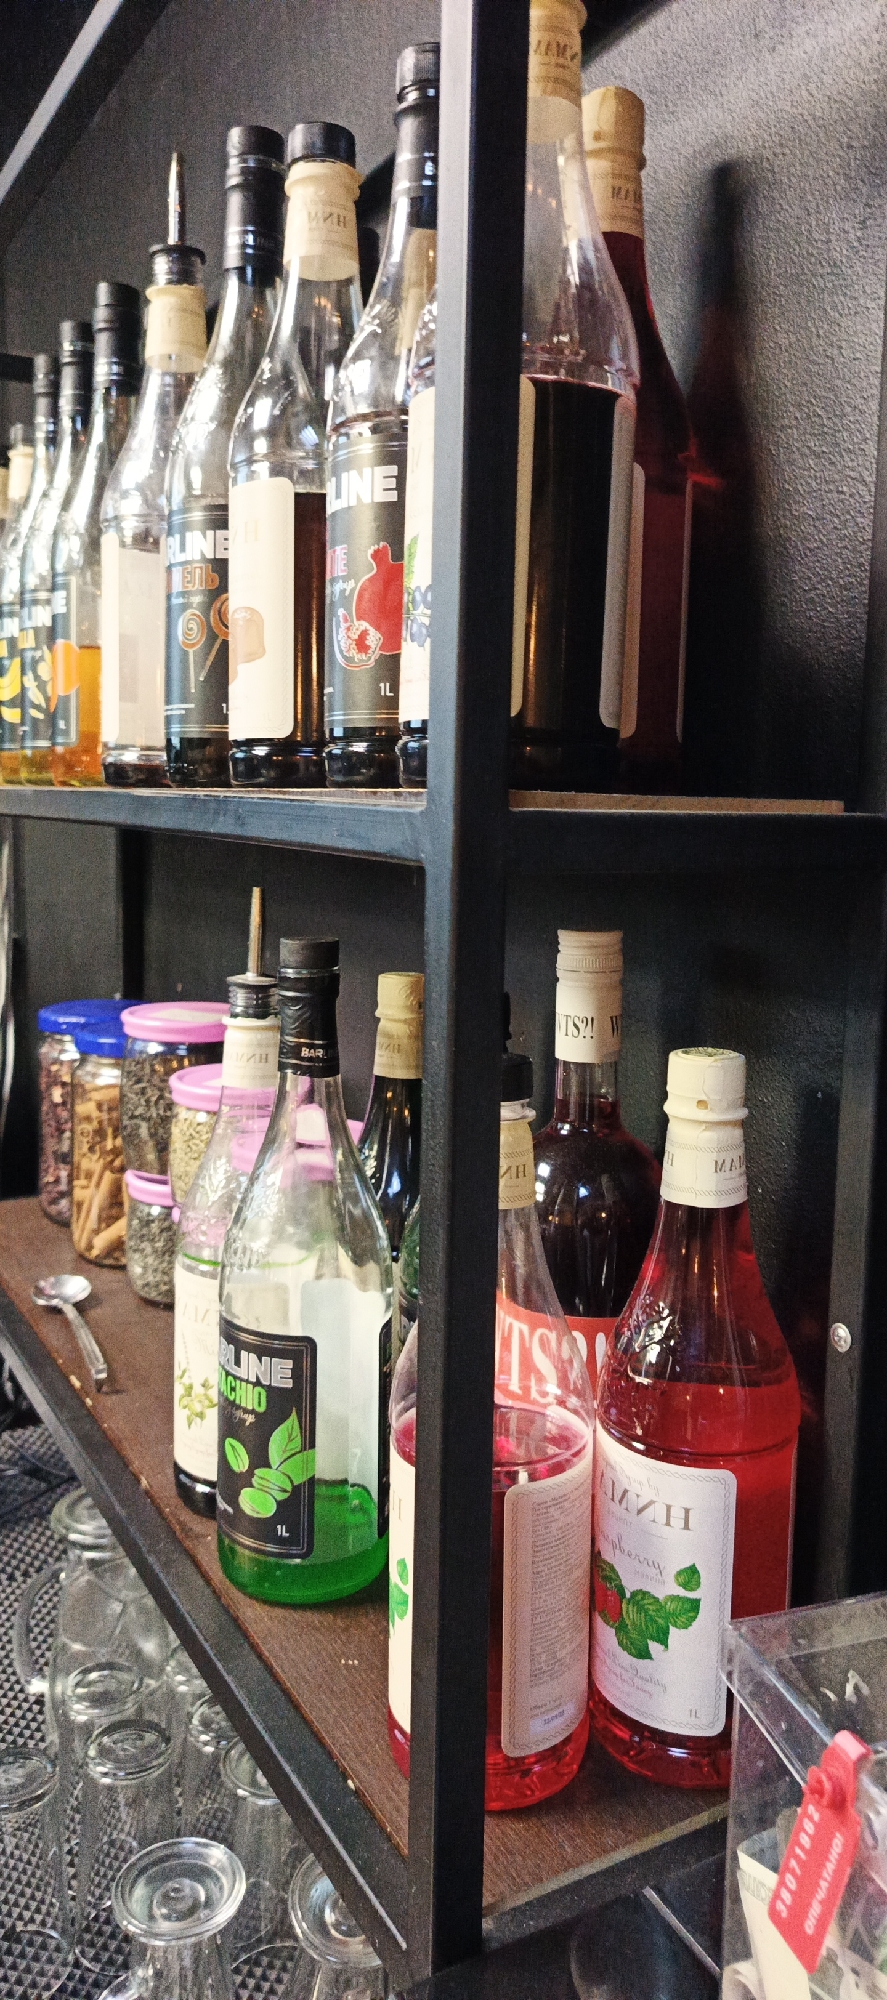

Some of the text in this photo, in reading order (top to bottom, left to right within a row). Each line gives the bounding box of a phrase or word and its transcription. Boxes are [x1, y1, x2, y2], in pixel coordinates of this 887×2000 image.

[326, 544, 348, 580] TE
[378, 683, 395, 697] 1L
[276, 1524, 290, 1538] 1L
